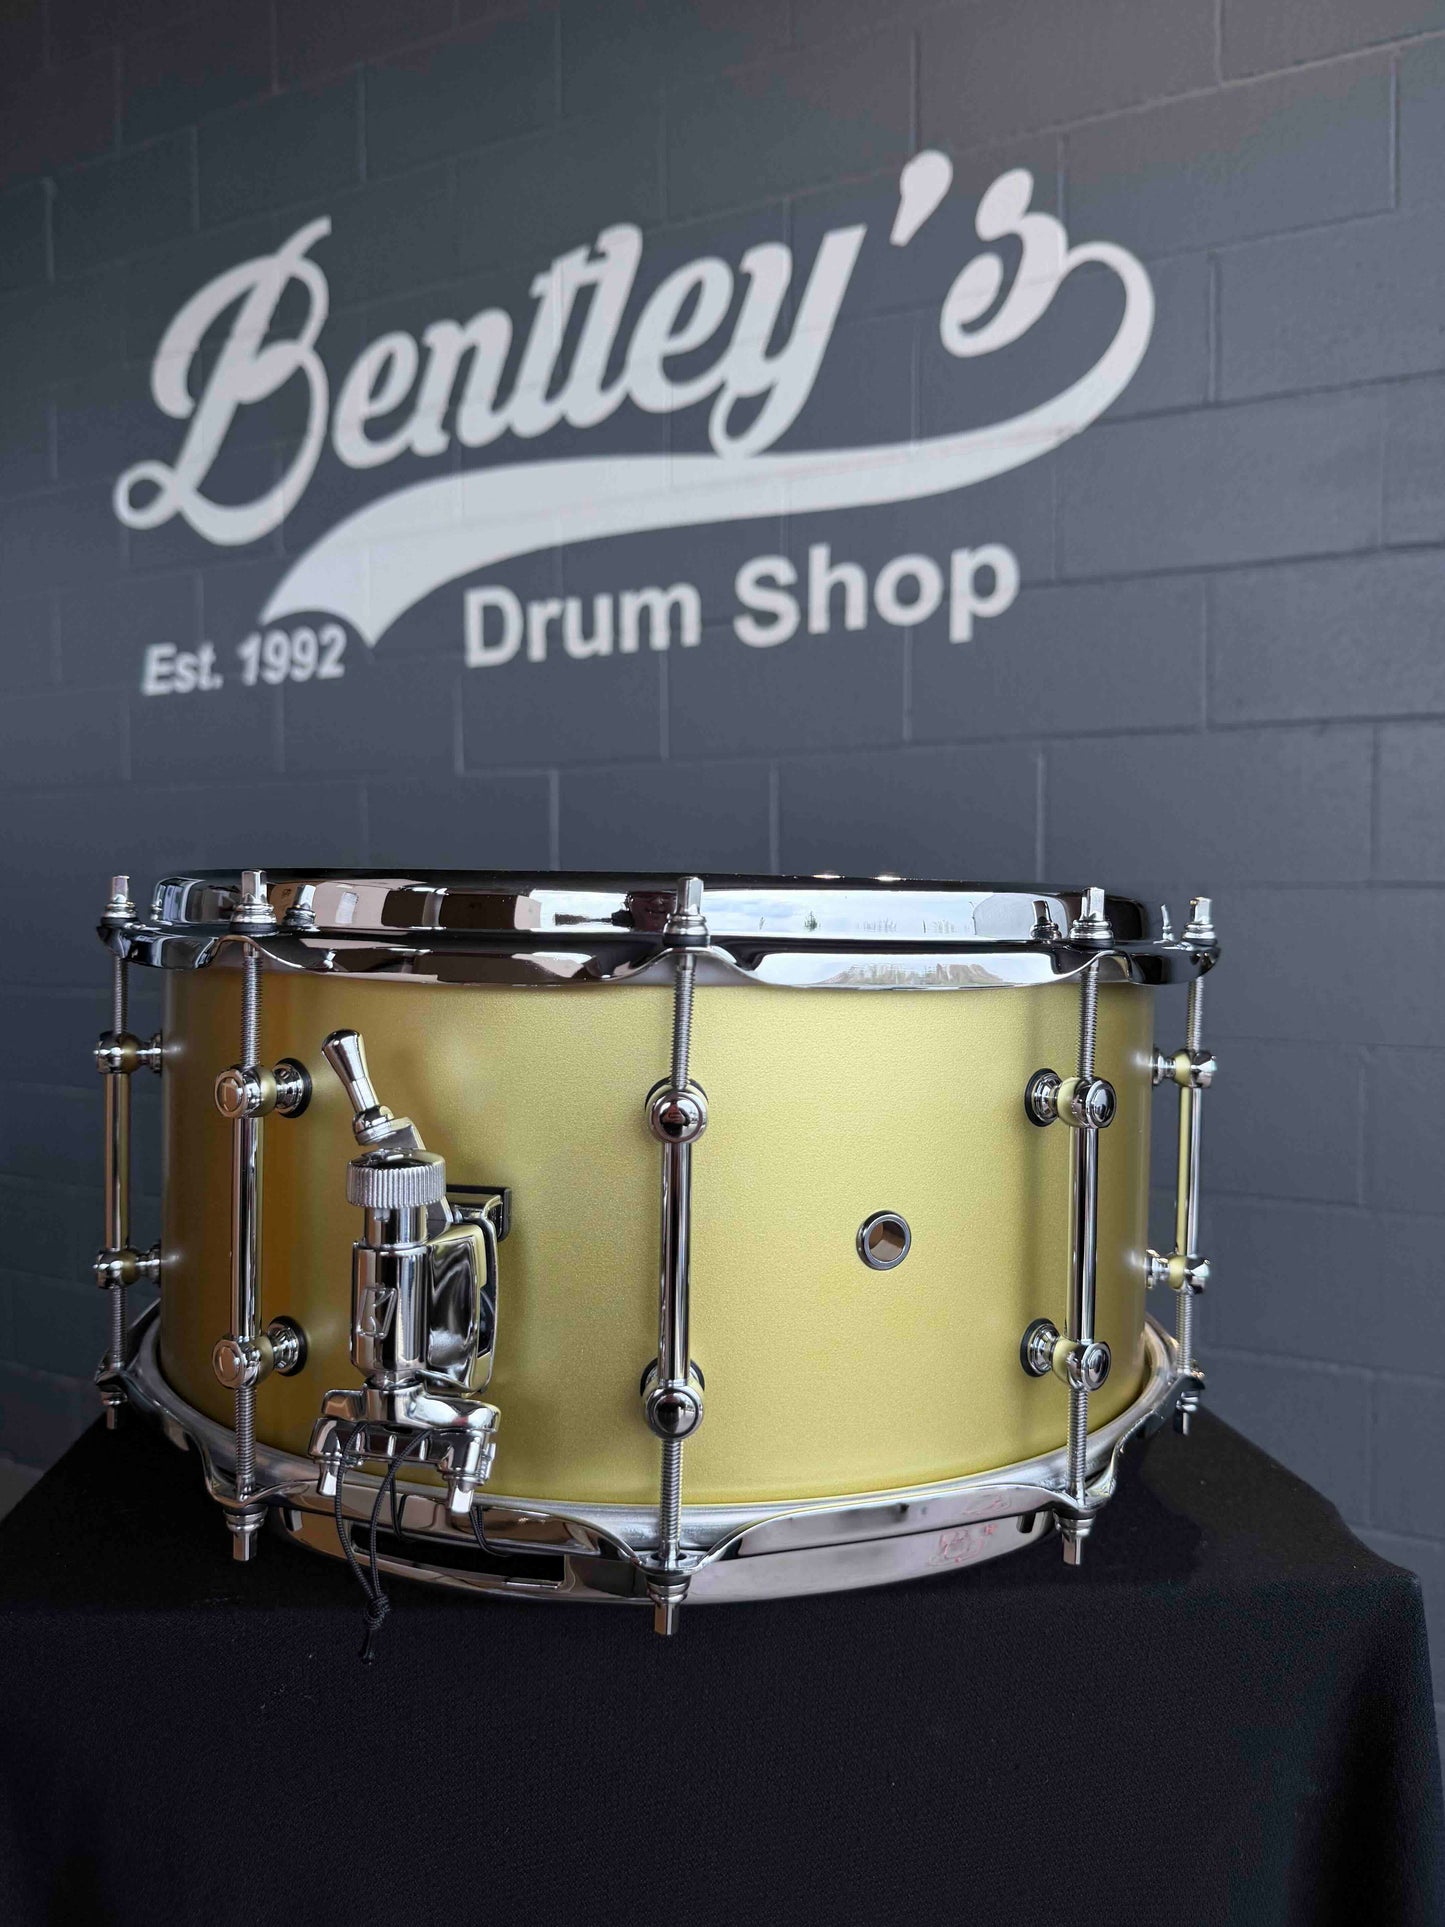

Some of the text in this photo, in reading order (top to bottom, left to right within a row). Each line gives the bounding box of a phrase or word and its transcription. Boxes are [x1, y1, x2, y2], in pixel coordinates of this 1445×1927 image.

[113, 149, 1156, 546] Bentley's
[142, 624, 348, 696] Est. 1992
[463, 542, 1022, 668] Drum Shop
